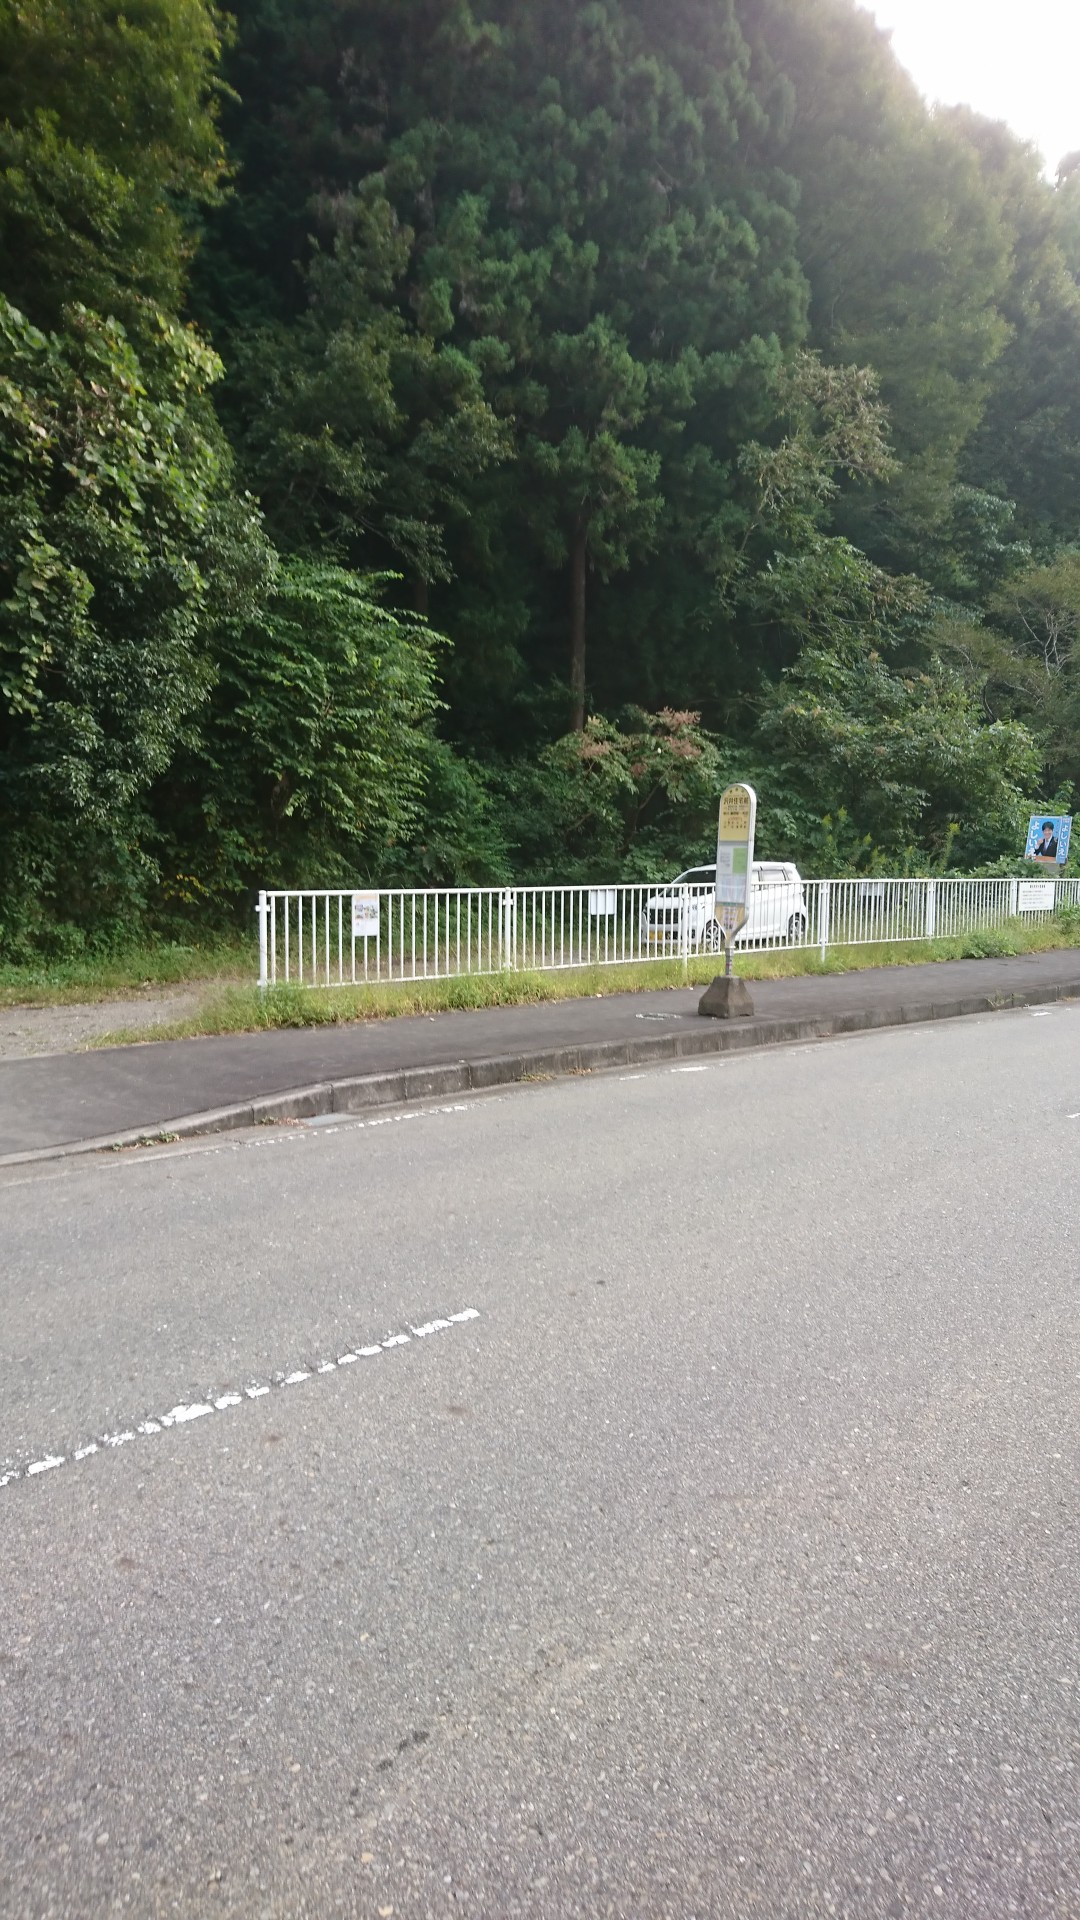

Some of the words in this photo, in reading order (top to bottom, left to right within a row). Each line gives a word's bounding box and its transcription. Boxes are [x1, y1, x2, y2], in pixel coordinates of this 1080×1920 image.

[1027, 821, 1040, 860] よしいえ
[1058, 825, 1068, 856] よしいえ
